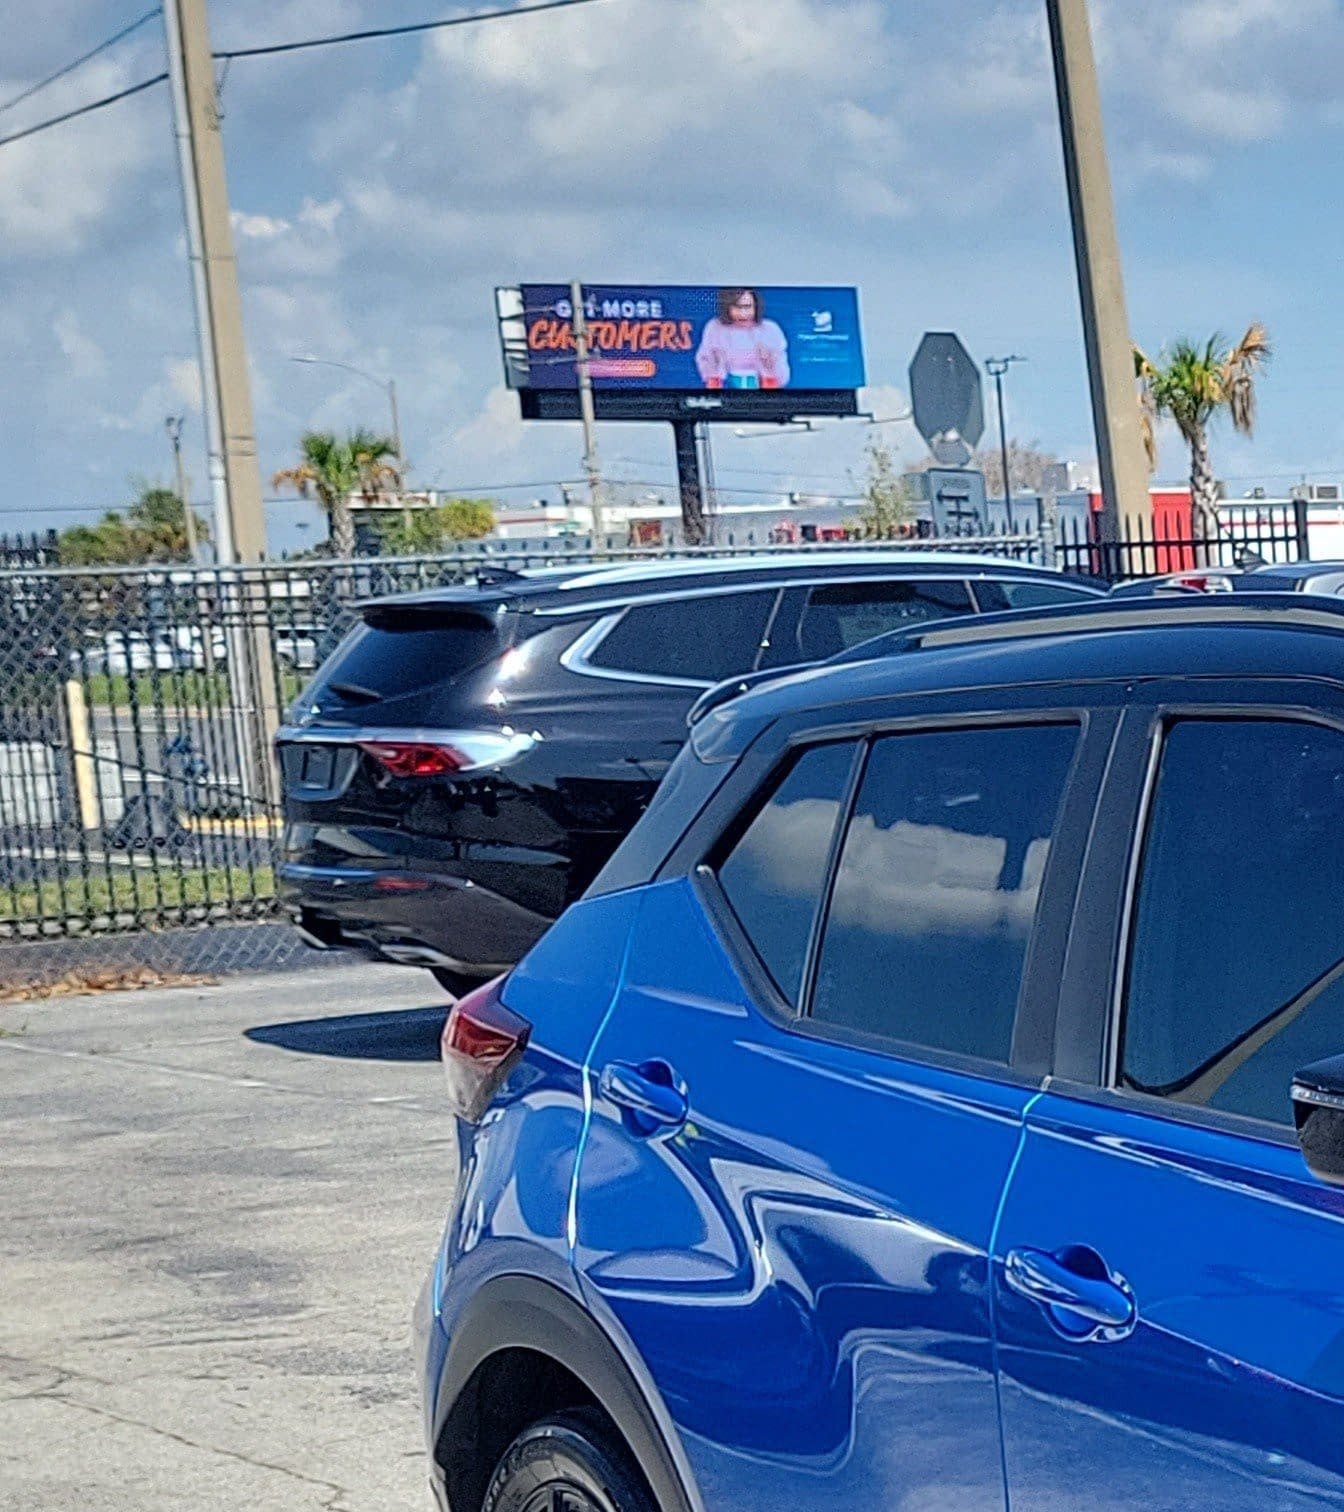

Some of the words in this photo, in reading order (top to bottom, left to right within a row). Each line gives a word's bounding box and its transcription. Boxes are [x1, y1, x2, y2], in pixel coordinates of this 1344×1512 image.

[555, 299, 598, 318] GT
[602, 299, 663, 318] MORE
[528, 318, 692, 353] CUTOMERS
